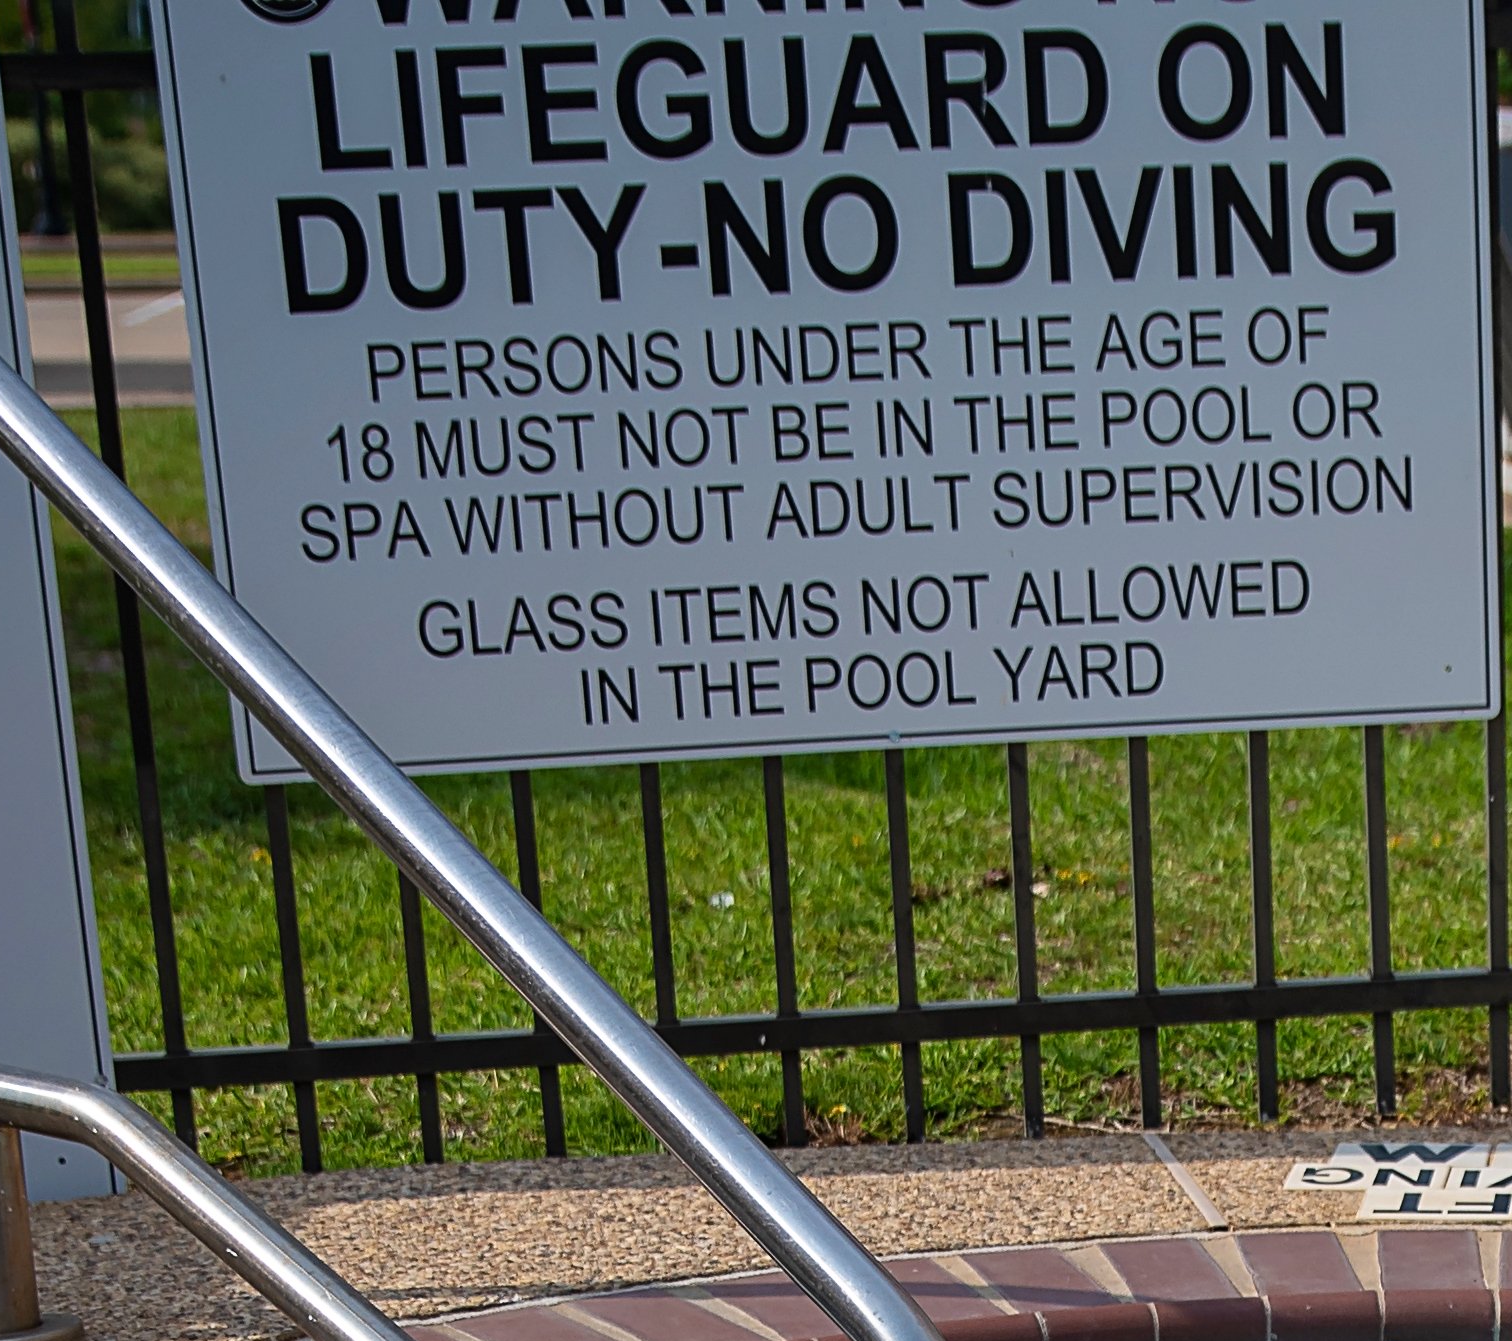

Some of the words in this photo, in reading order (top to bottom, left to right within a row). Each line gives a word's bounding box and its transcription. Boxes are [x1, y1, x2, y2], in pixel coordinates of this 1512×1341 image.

[308, 28, 1108, 172] LIFEGUARD
[1157, 20, 1346, 142] ON
[276, 173, 899, 315] DUTY-NO
[946, 157, 1396, 288] DIVING
[366, 329, 682, 403] PERSONS
[704, 320, 932, 388] UNDER
[947, 315, 1075, 377] THE
[1095, 309, 1226, 372] AGE
[1247, 304, 1329, 366] OF
[327, 422, 394, 483] 18
[414, 412, 594, 480] MUST
[617, 405, 749, 470] NOT
[771, 401, 854, 462] BE
[876, 397, 933, 458] IN
[952, 391, 1079, 454] THE
[1100, 384, 1272, 449] POOL
[1292, 380, 1382, 440] OR
[300, 499, 431, 563] SPA
[443, 483, 744, 555] WITHOUT
[766, 473, 970, 540] ADULT
[992, 454, 1412, 529] SUPERVISION
[418, 590, 628, 658] GLASS
[649, 579, 839, 646] ITEMS
[860, 572, 989, 635] NOT
[1010, 559, 1310, 628] ALLOWED
[580, 666, 639, 725] IN
[657, 658, 784, 721] THE
[804, 649, 976, 713] POOL
[992, 640, 1164, 702] YARD
[1372, 1192, 1512, 1215] FT
